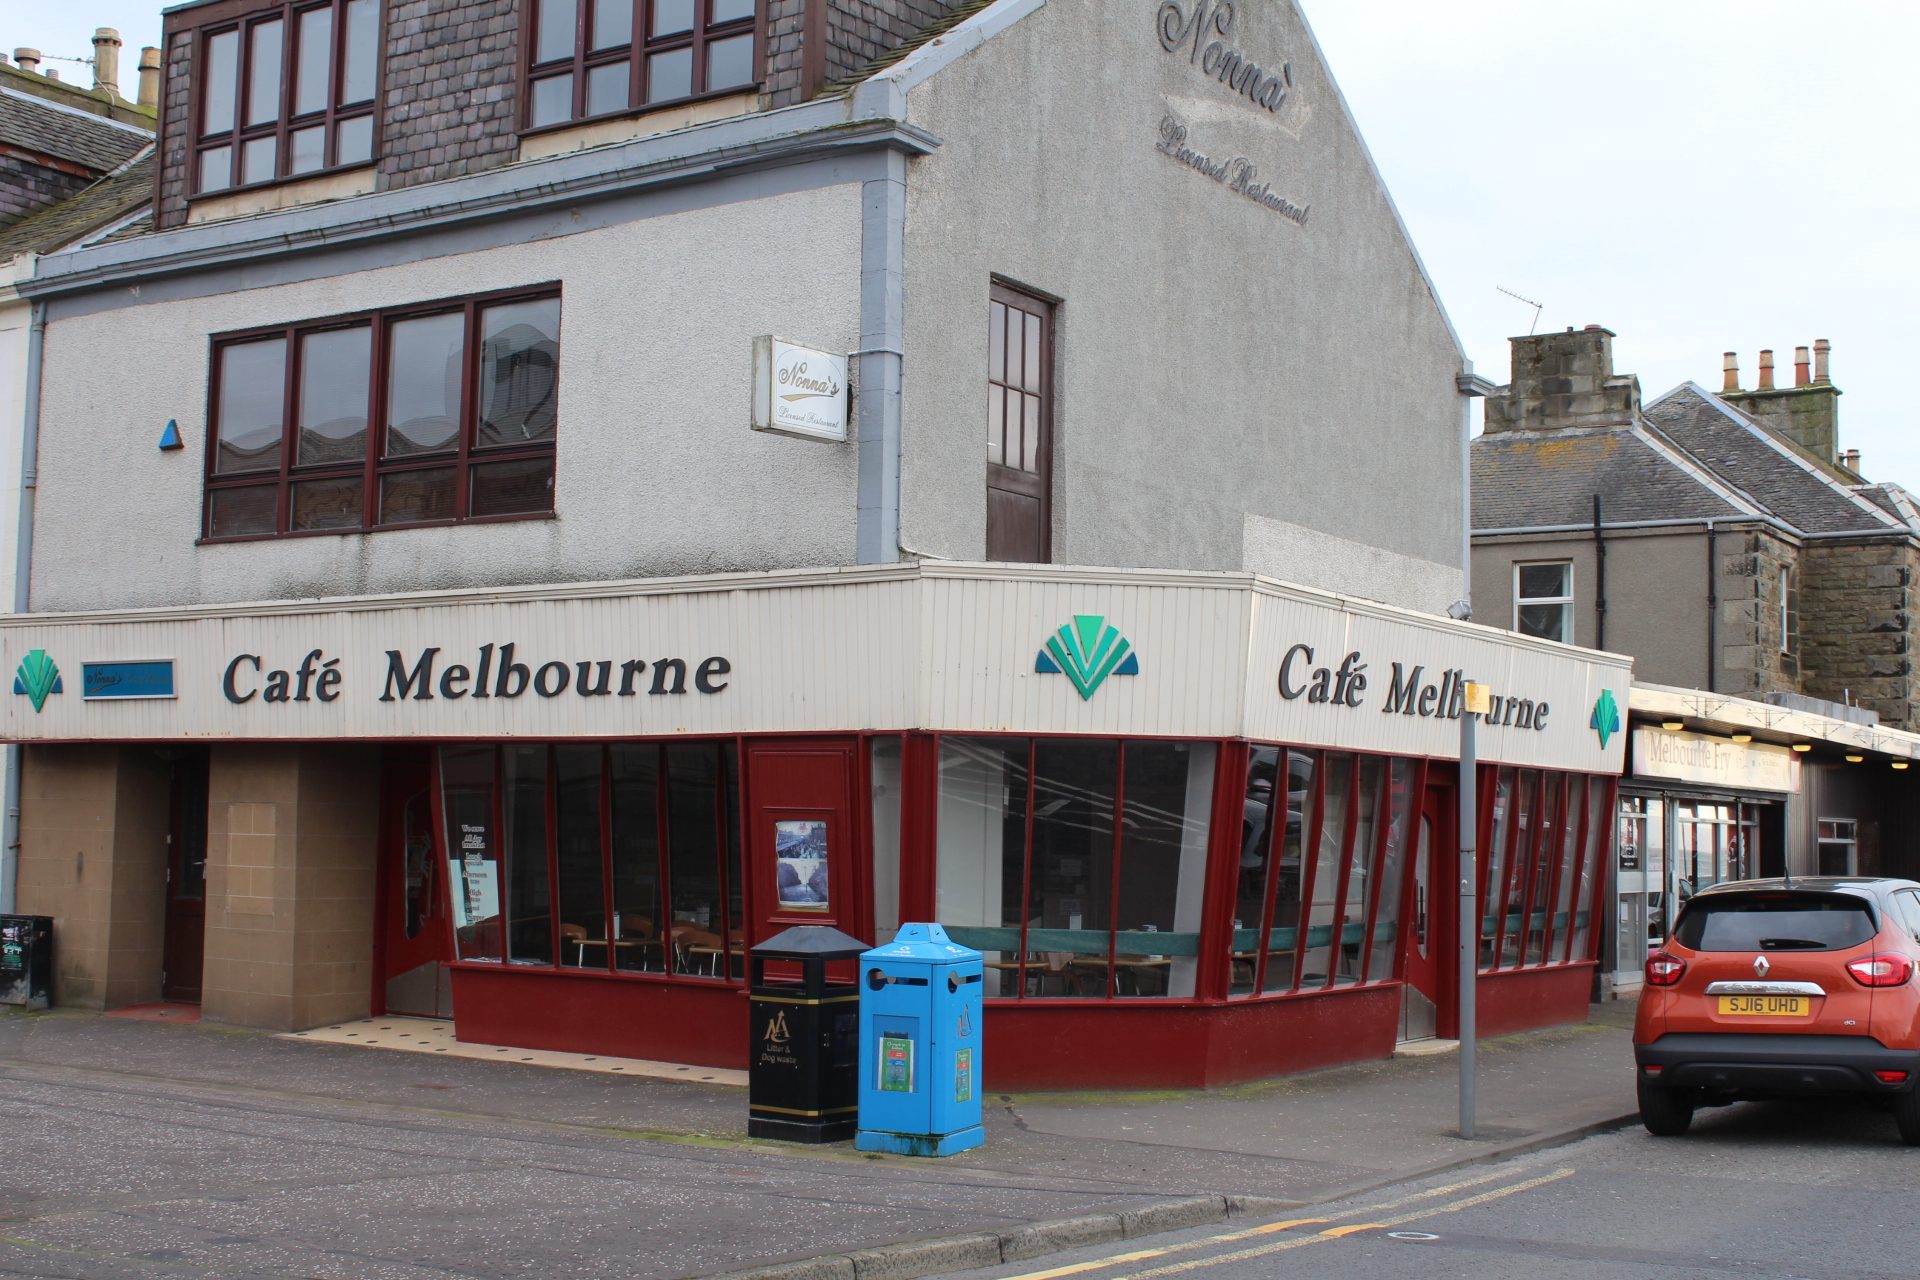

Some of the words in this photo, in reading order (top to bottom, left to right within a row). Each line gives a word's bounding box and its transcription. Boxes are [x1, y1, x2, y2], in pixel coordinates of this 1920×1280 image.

[1154, 114, 1230, 184] Licensed
[1230, 157, 1312, 226] Restaurant
[778, 361, 840, 396] Nonna's
[778, 405, 806, 422] Licensed
[806, 410, 840, 429] Restaurant
[222, 648, 342, 705] Café
[378, 641, 732, 702] Melbourne
[1278, 643, 1368, 708] Café
[1381, 661, 1550, 731] Melburne
[1713, 742, 1731, 780] Fry
[1729, 997, 1764, 1012] SJ16
[1768, 998, 1799, 1013] UHD
[761, 1052, 776, 1064] Dog
[776, 1056, 797, 1065] waste
[766, 1043, 784, 1053] Litter
[784, 1044, 791, 1054] &
